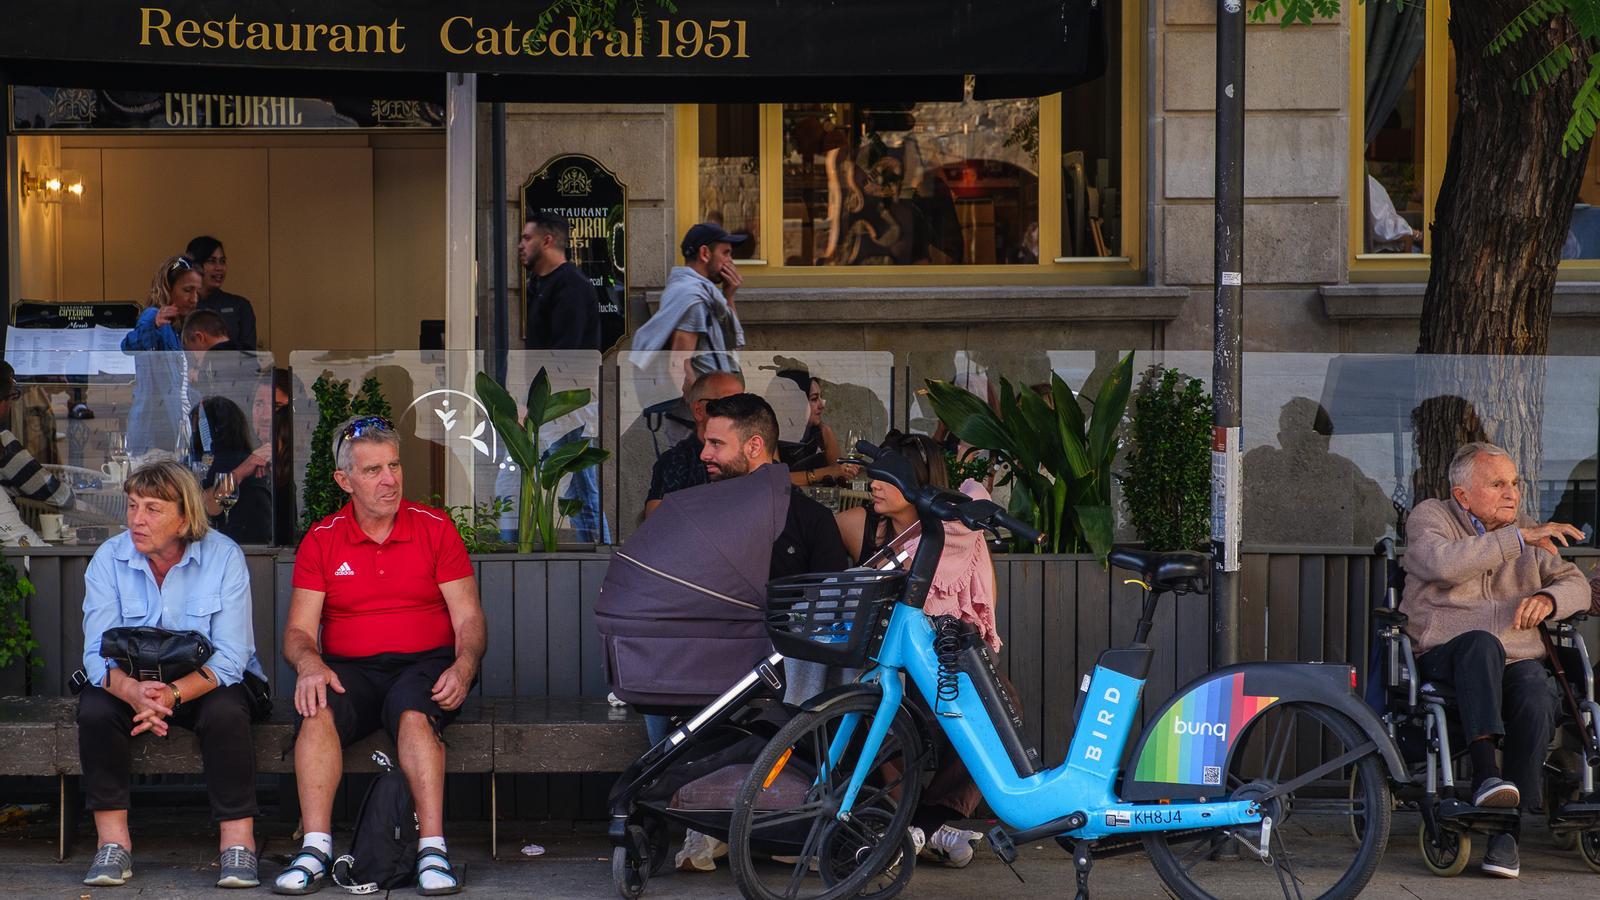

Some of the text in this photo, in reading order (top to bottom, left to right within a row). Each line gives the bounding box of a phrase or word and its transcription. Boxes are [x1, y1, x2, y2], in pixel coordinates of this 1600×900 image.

[139, 7, 406, 54] Restaurant
[439, 16, 750, 58] Catedral 1951
[164, 92, 302, 126] CATEDRAL
[568, 217, 610, 238] EDRAL
[1085, 687, 1121, 762] BIRD
[1174, 715, 1226, 742] bunq
[1134, 809, 1183, 825] KH8J4
